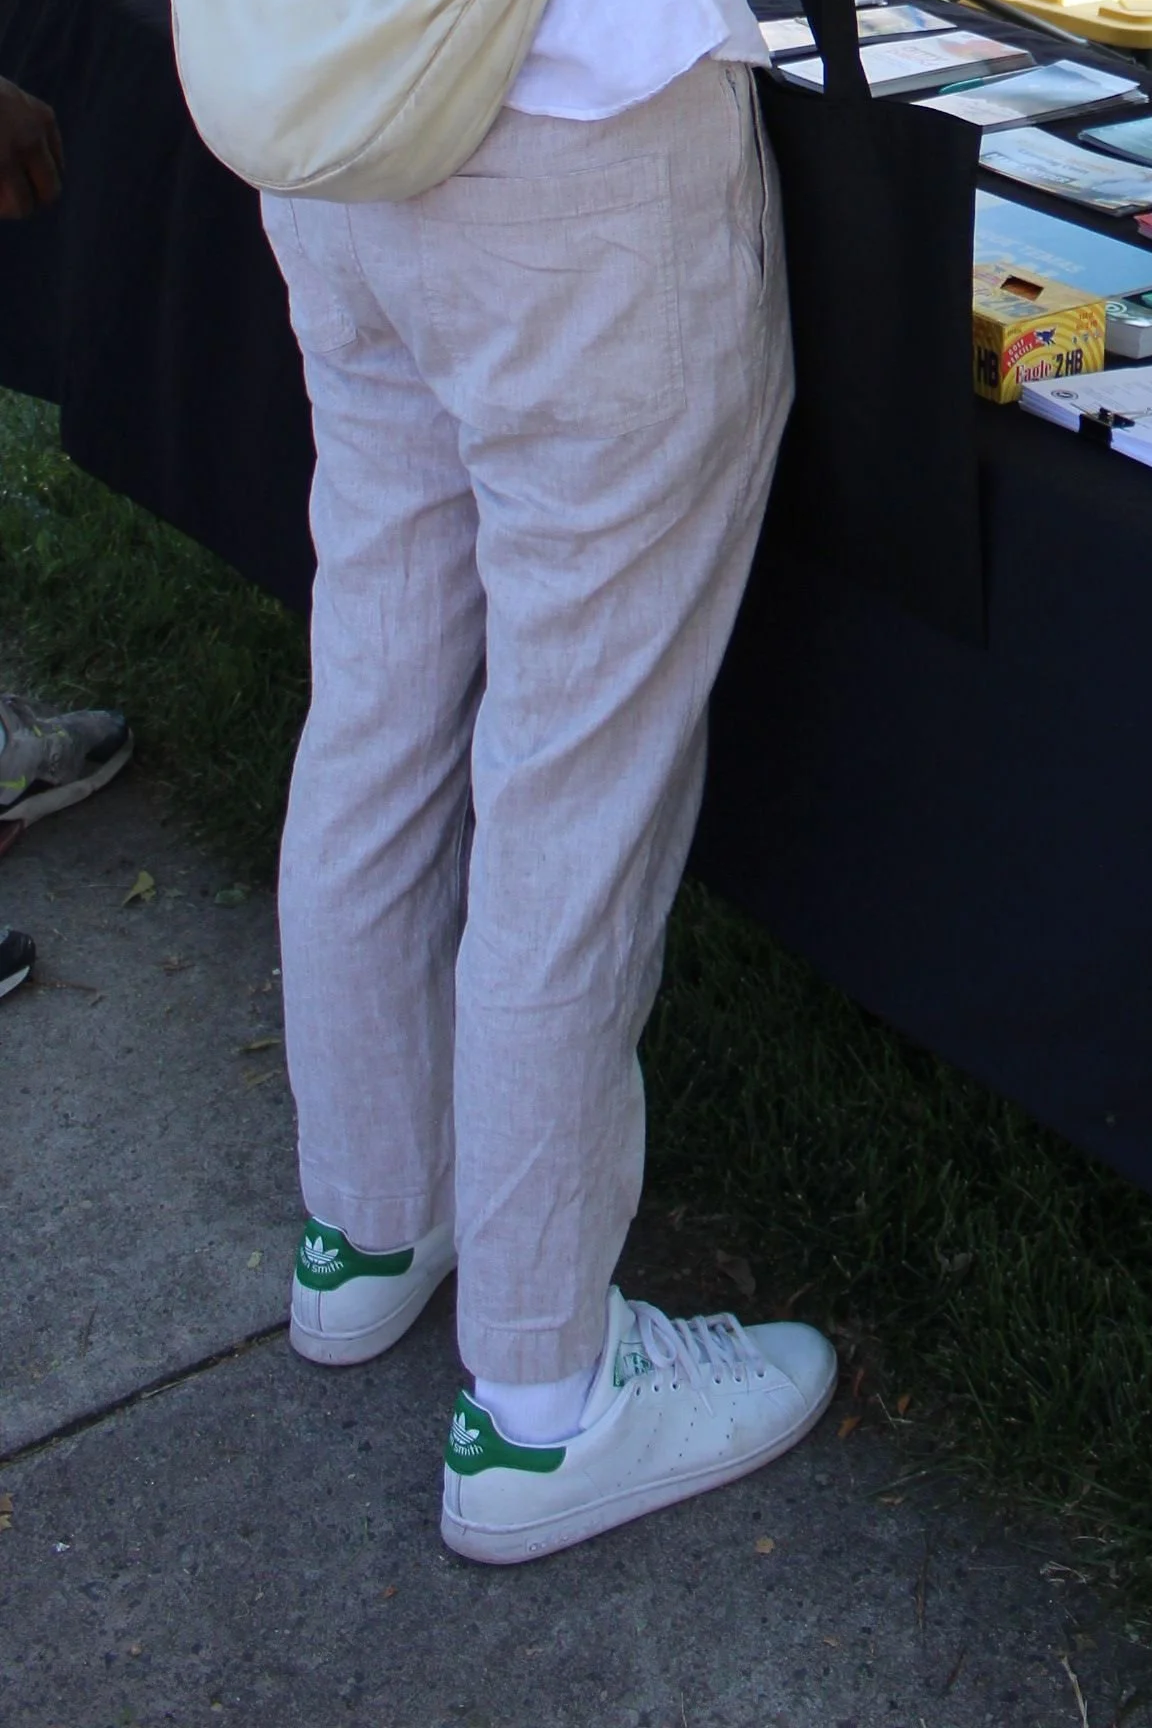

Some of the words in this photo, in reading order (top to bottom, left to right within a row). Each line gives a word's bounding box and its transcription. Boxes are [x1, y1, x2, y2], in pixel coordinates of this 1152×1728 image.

[1015, 360, 1052, 384] Eagle
[1065, 348, 1083, 377] HB
[312, 1260, 344, 1273] smith
[453, 1443, 484, 1456] smith
